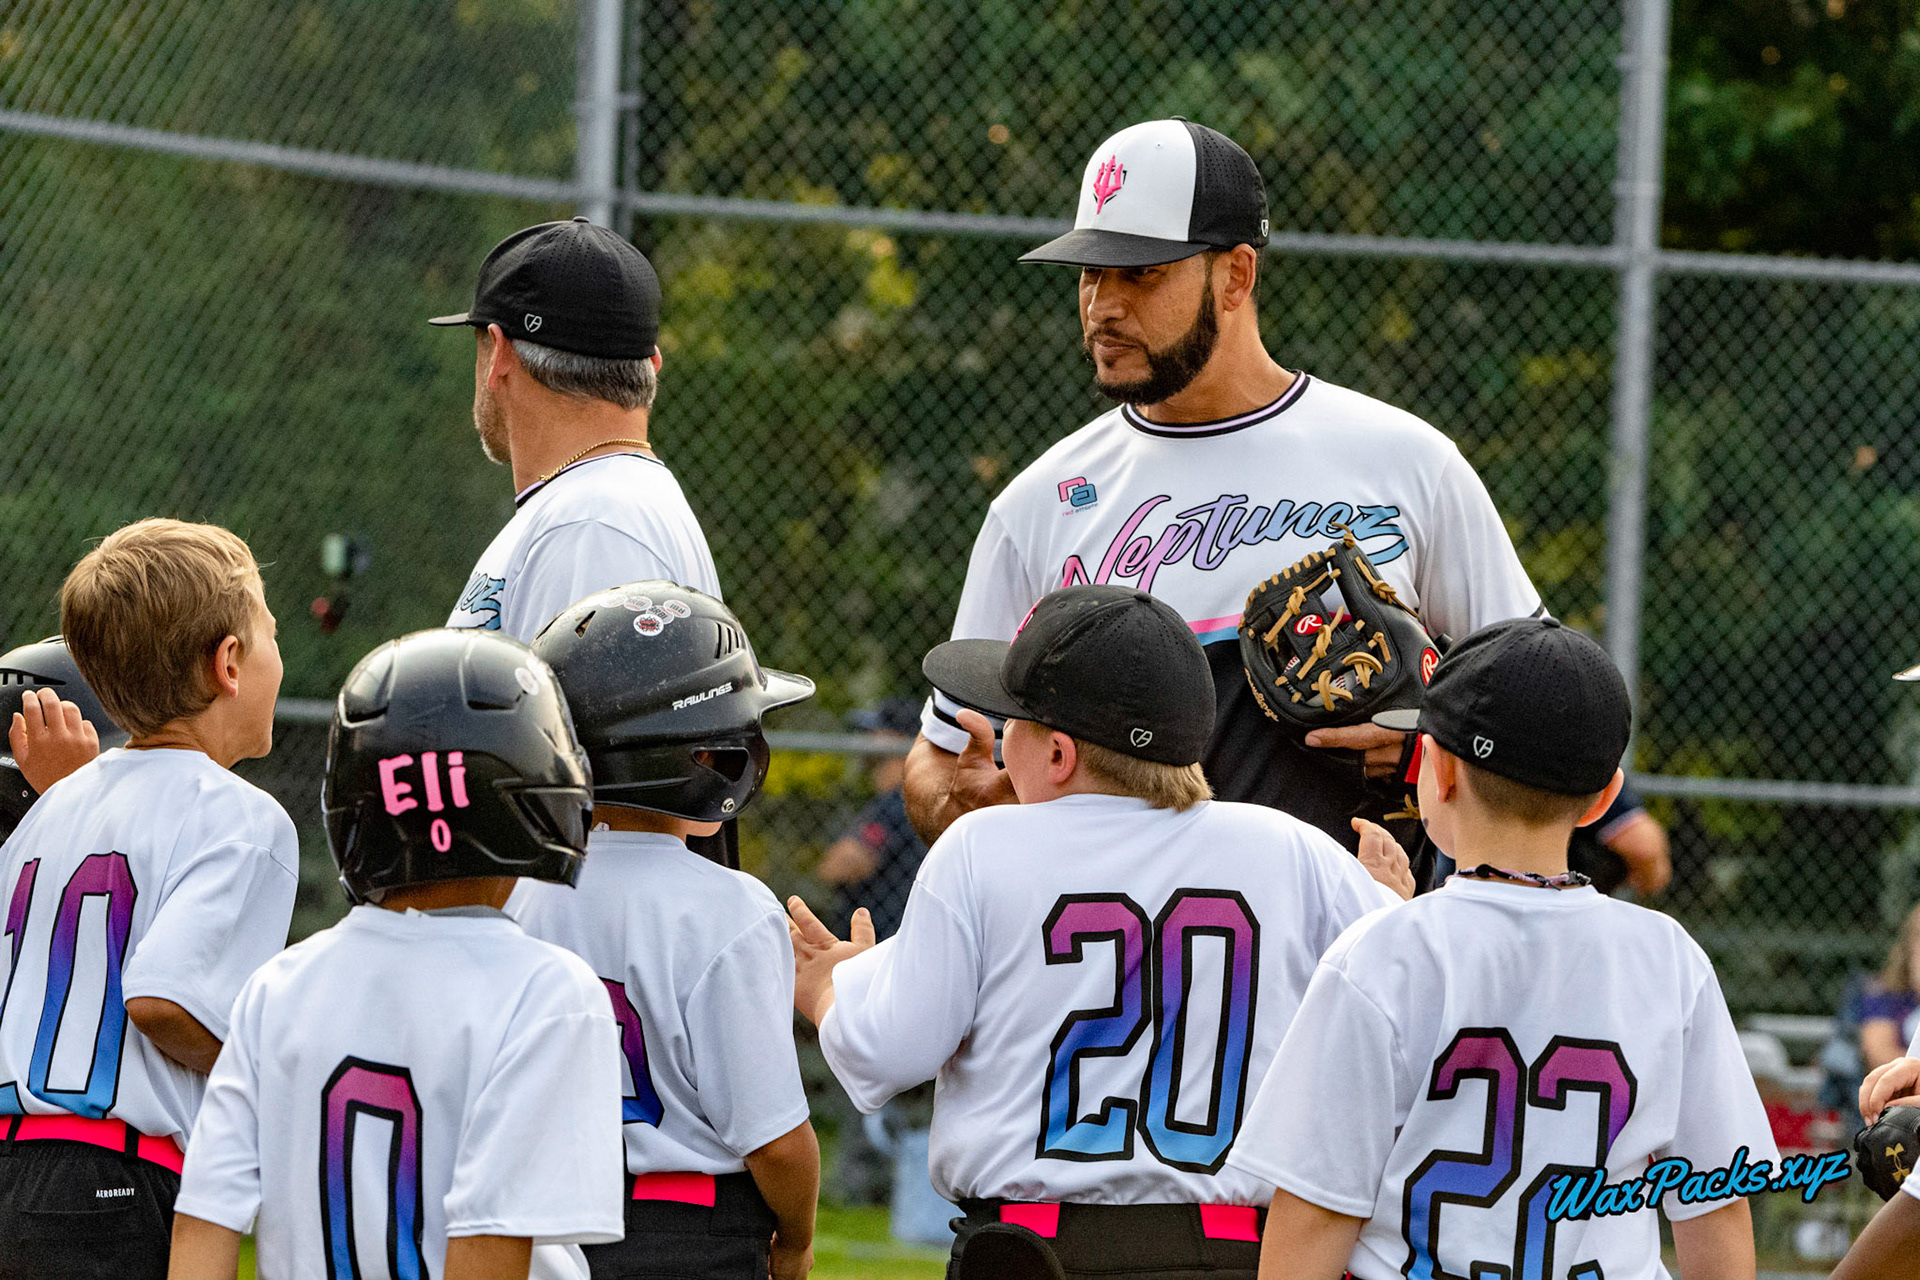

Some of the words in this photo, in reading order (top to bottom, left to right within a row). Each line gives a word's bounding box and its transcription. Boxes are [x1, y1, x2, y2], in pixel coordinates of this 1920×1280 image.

[1061, 495, 1410, 593] Neptunez
[672, 682, 733, 711] RAWLINGS
[378, 751, 470, 816] Eli
[0, 851, 138, 1119] 10
[1036, 888, 1260, 1175] 20
[95, 1187, 135, 1198] AEROREADY
[319, 1055, 429, 1280] 0
[1401, 1027, 1638, 1280] 22
